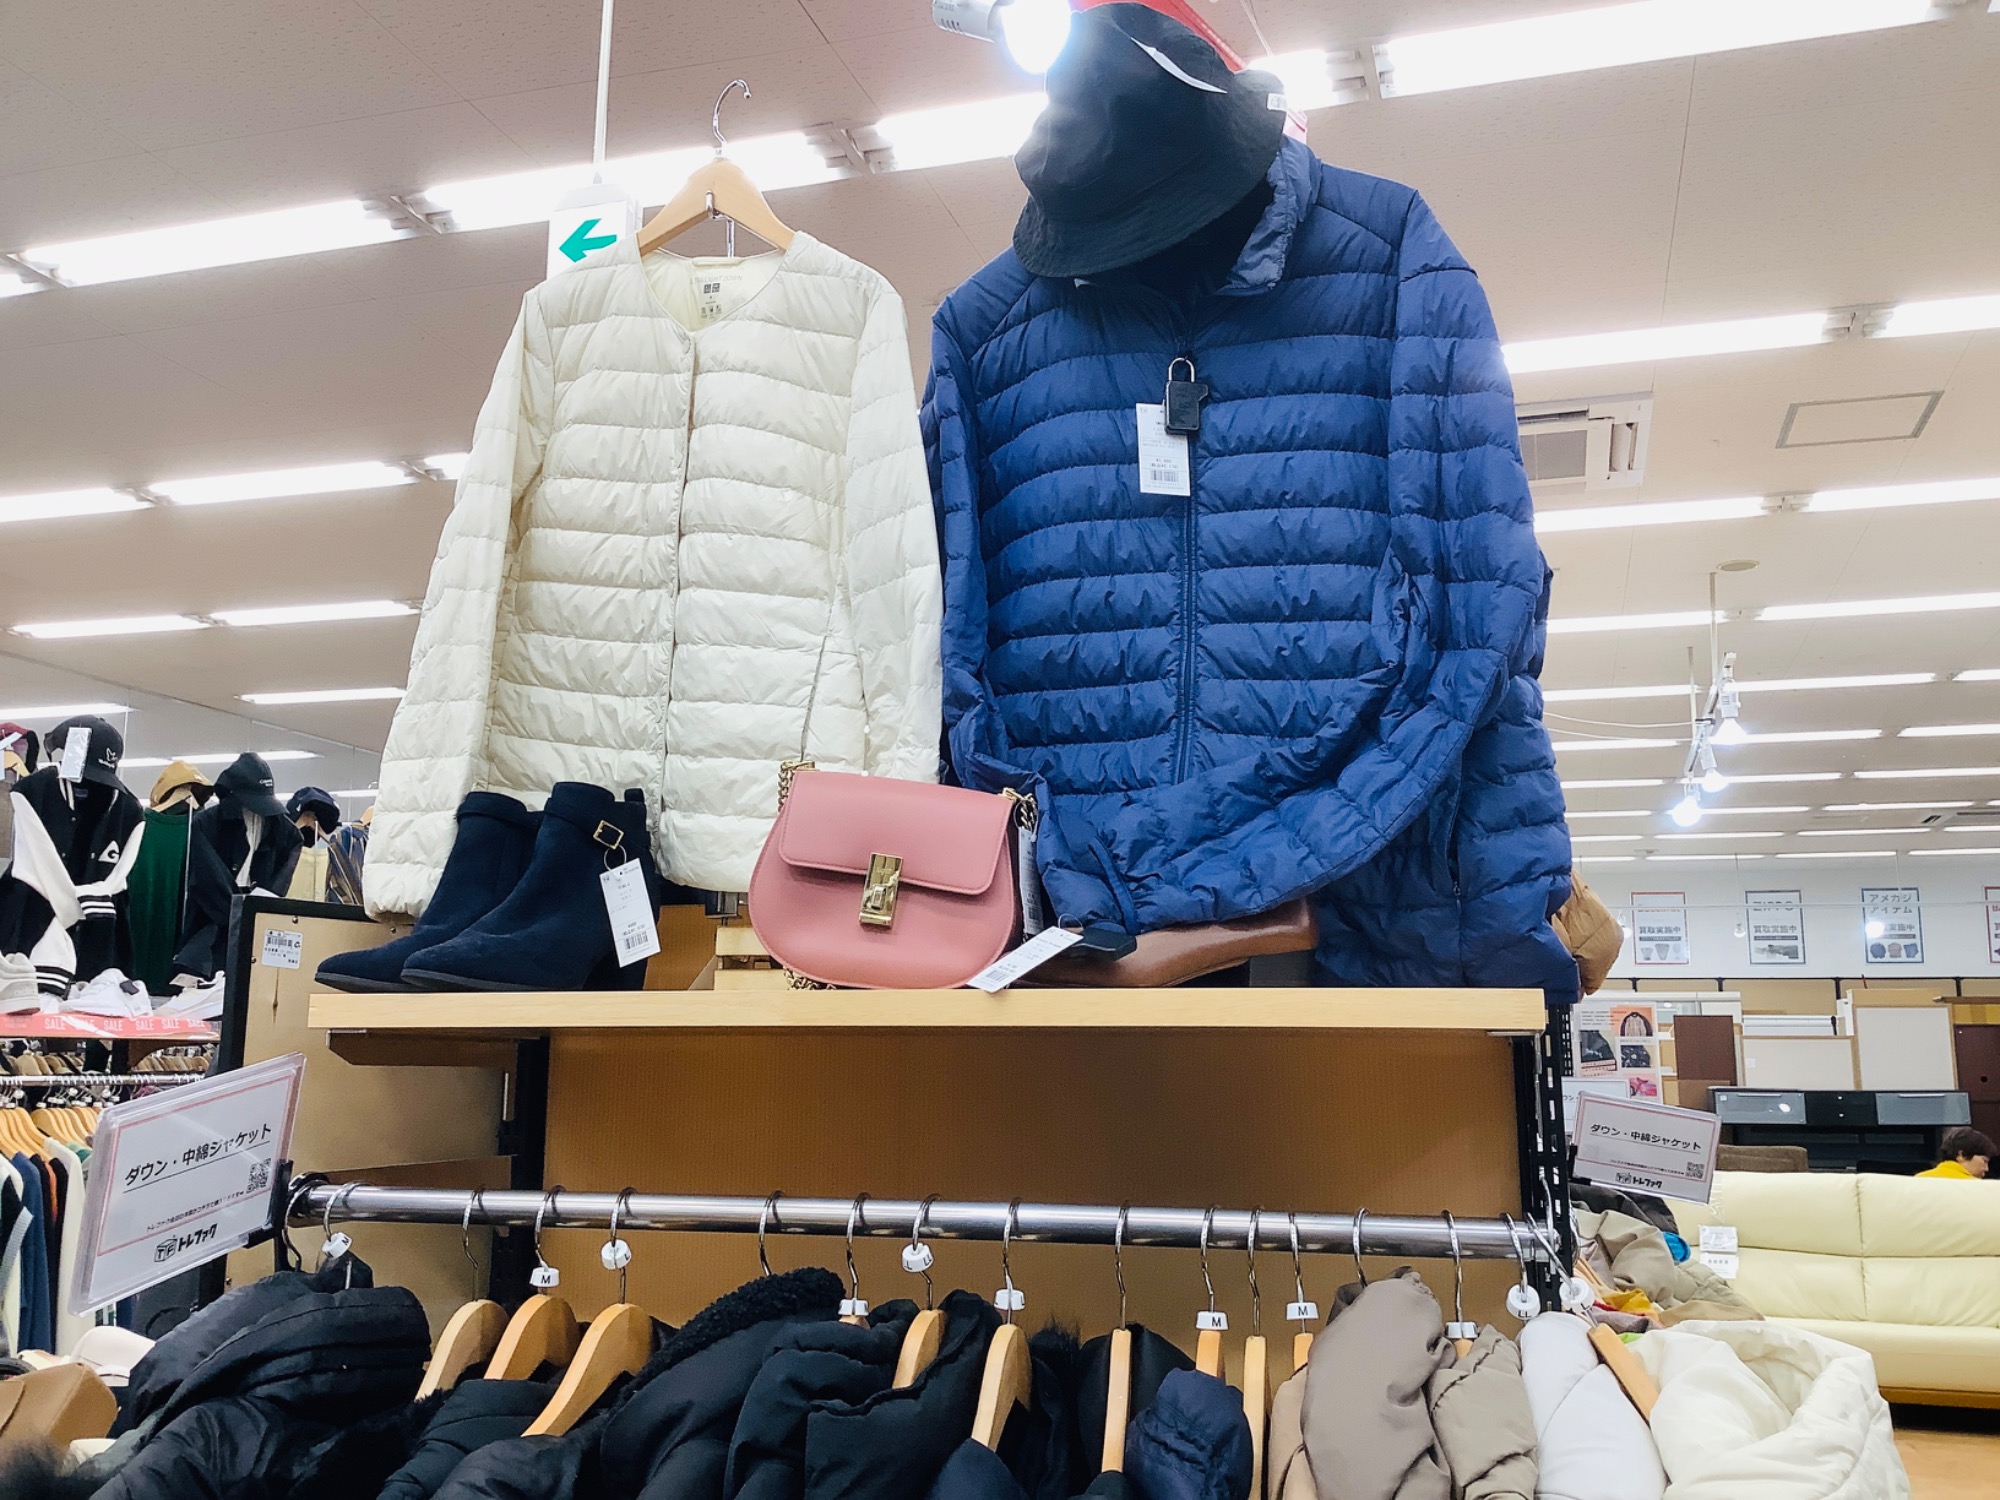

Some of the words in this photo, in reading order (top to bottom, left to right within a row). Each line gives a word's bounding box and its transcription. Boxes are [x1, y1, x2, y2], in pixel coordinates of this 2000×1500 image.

[1869, 893, 1912, 903] アメカジ
[103, 1020, 124, 1032] SALE
[135, 1020, 155, 1031] SALE
[161, 1018, 181, 1029] SALE
[541, 1275, 551, 1284] M
[1298, 1306, 1309, 1316] M
[1211, 1316, 1222, 1327] M
